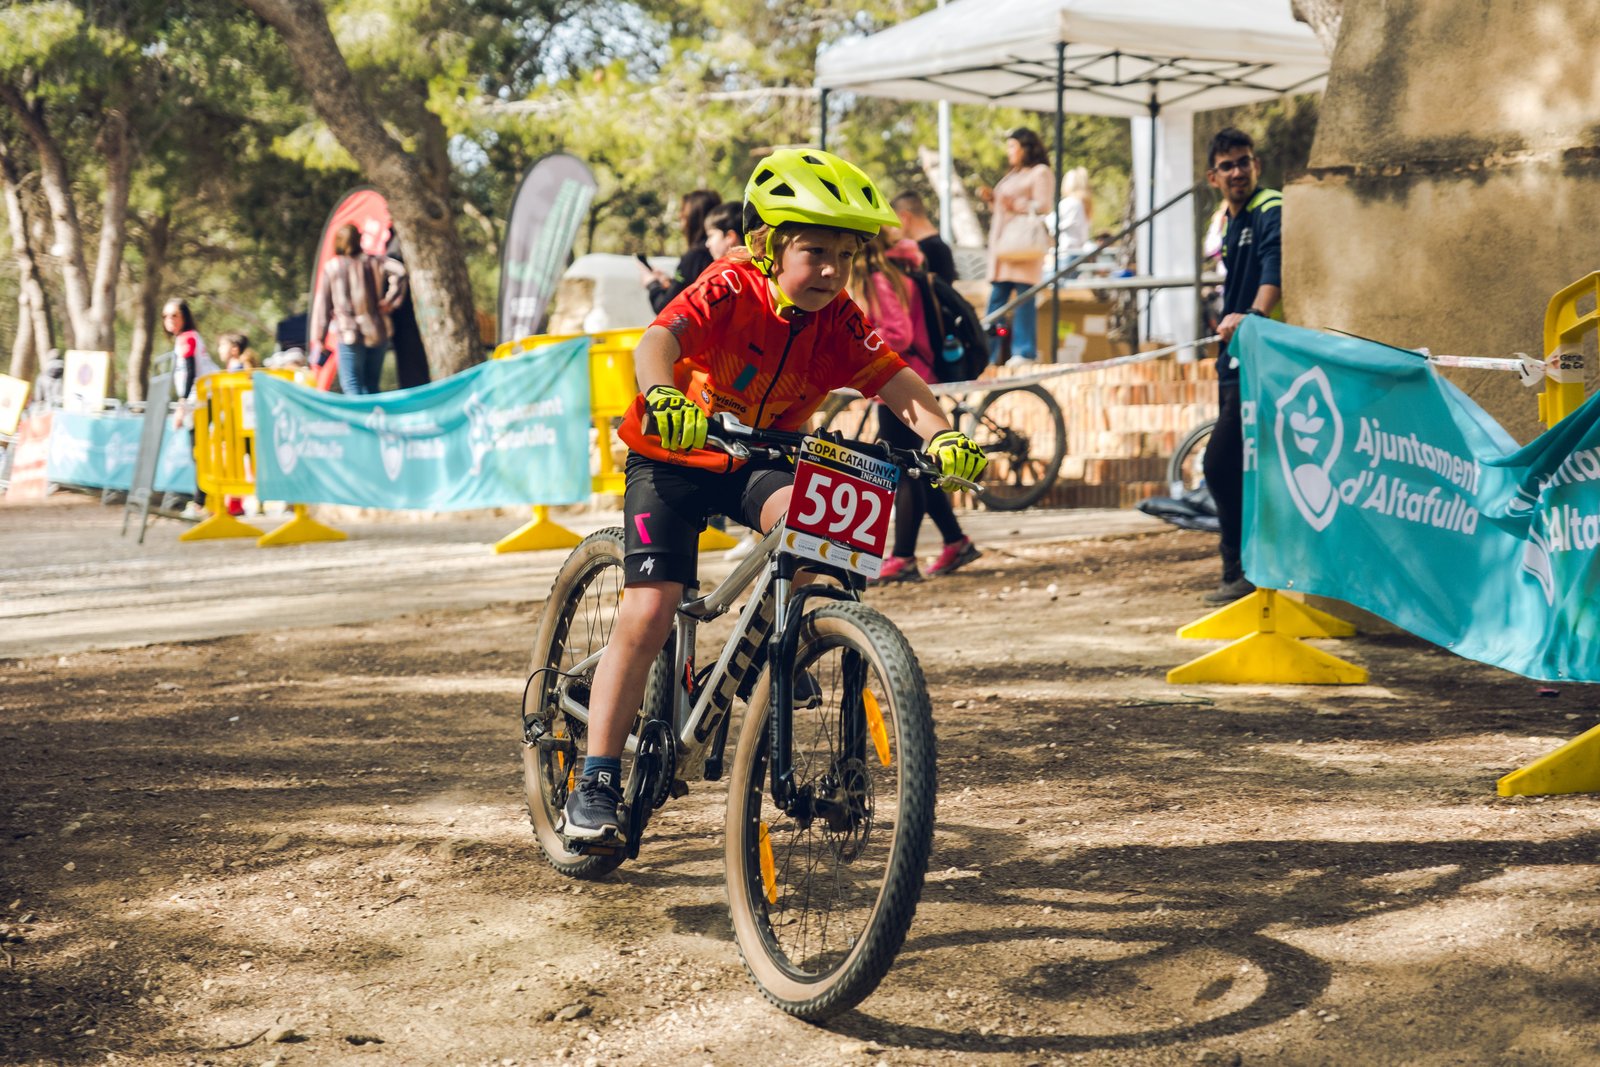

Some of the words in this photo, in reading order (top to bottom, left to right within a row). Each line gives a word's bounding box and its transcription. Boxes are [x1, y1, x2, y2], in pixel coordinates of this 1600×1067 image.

[807, 454, 821, 463] 2024
[807, 441, 837, 460] COPA
[839, 451, 897, 480] CATALUNYA
[860, 470, 893, 490] INFANTIL
[1353, 416, 1482, 497] Ajuntament
[797, 472, 882, 546] 592
[1338, 470, 1480, 536] d'Altafulla
[693, 590, 774, 745] SCOT
